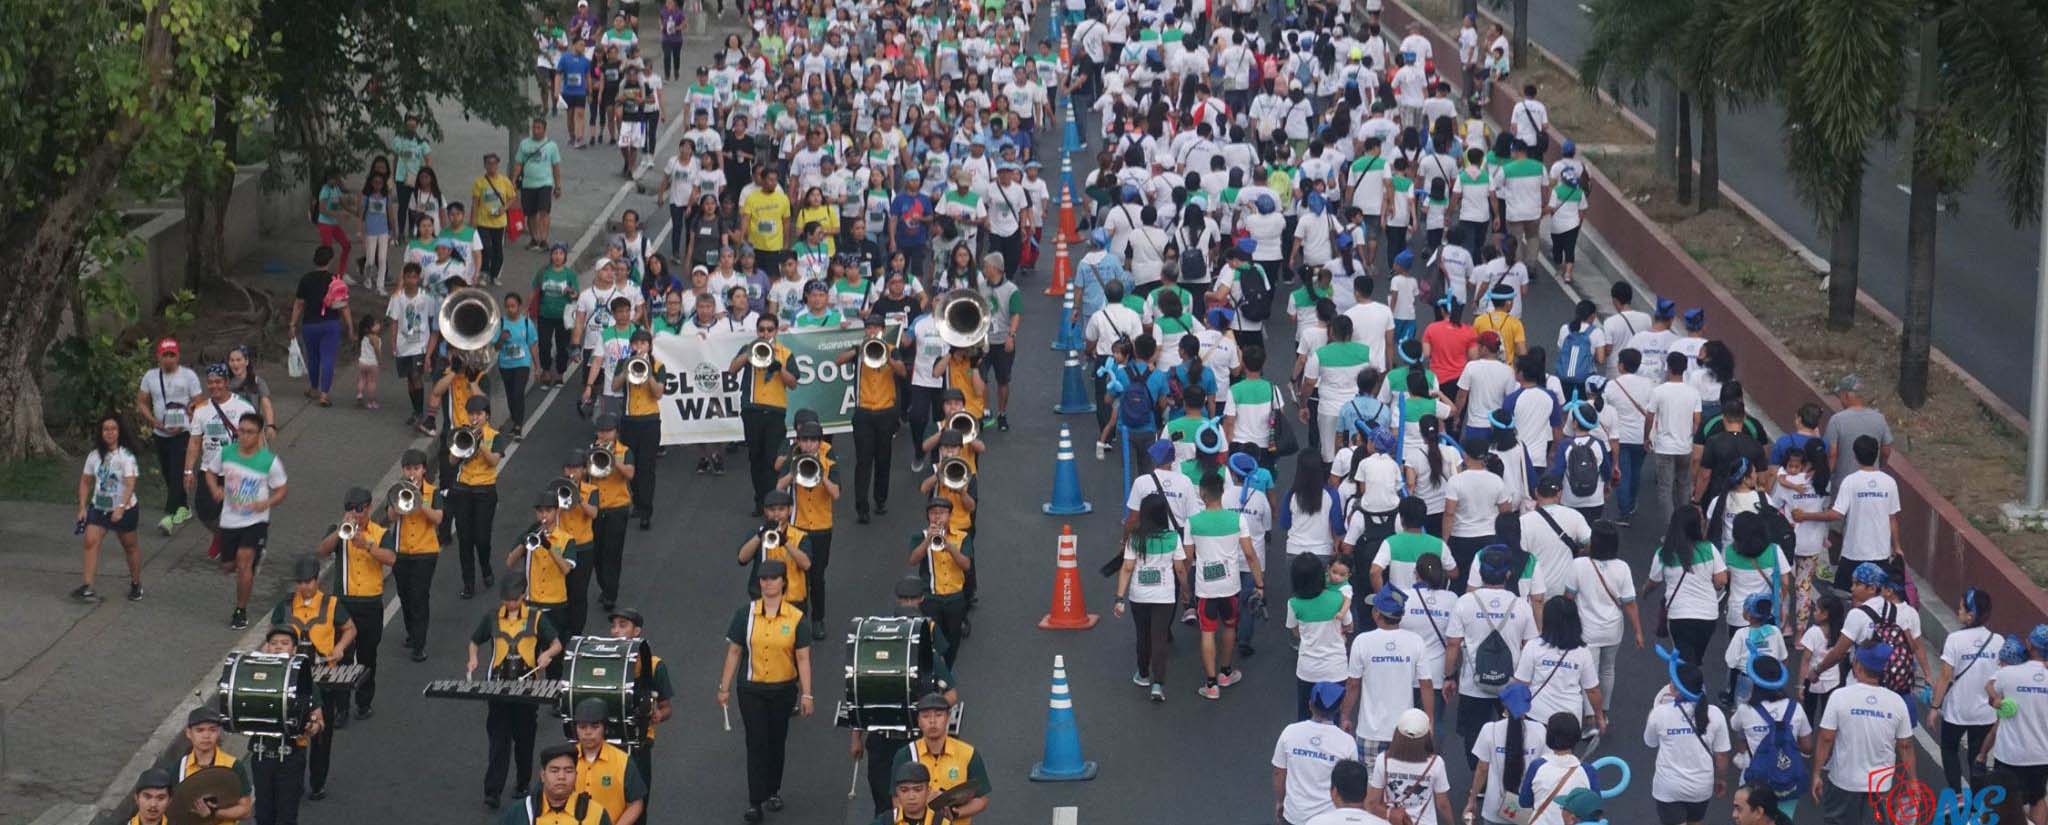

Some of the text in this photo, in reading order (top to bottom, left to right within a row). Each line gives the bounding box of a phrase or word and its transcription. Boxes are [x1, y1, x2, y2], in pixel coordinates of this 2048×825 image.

[796, 355, 856, 385] Sou
[675, 397, 740, 421] WAL
[1542, 660, 1572, 669] CENRAL
[2017, 685, 2048, 694] CENTRA
[1850, 708, 1885, 719] CENTRAL
[1293, 748, 1328, 761] CENTRAL
